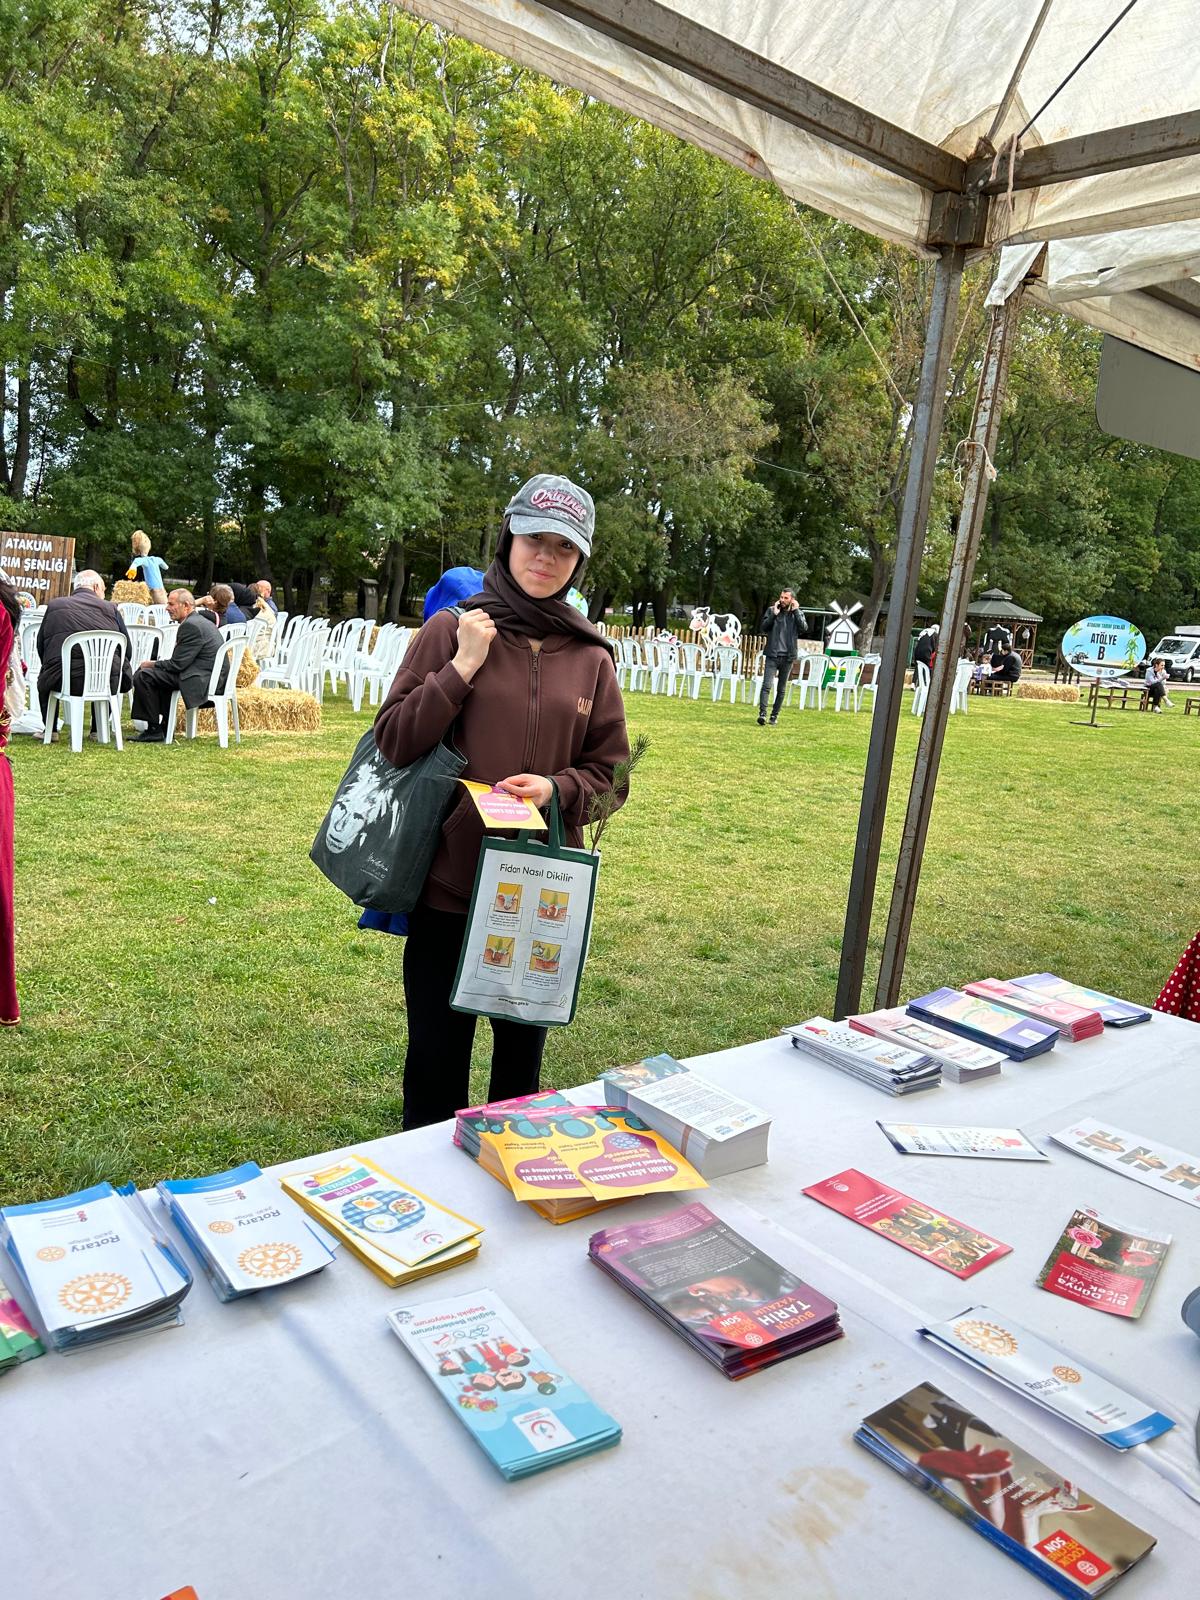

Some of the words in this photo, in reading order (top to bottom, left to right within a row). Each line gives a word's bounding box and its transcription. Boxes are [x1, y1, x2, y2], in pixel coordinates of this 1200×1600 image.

[5, 538, 52, 553] ATAKUM
[0, 555, 21, 568] RIM
[24, 557, 68, 573] ŞENLİĞİ
[9, 576, 51, 590] ATIRASI
[1090, 631, 1117, 646] ATÖLYE
[1097, 646, 1106, 660] B
[499, 863, 521, 874] Fidan
[522, 866, 544, 878] Nasıl
[546, 870, 574, 882] Dikilir
[522, 1174, 563, 1183] KANSERİ
[589, 1172, 628, 1184] KANSERİ
[237, 1209, 282, 1228] Rotary
[71, 1233, 121, 1253] Rotary
[1057, 1277, 1102, 1300] Dünya
[752, 1296, 797, 1316] YAZALIM
[1106, 1297, 1127, 1306] Bir
[720, 1315, 741, 1327] SON
[757, 1300, 811, 1326] TARİH
[775, 1310, 815, 1331] BUGÜN
[1024, 1377, 1061, 1391] Rotary
[1043, 1536, 1066, 1553] SON
